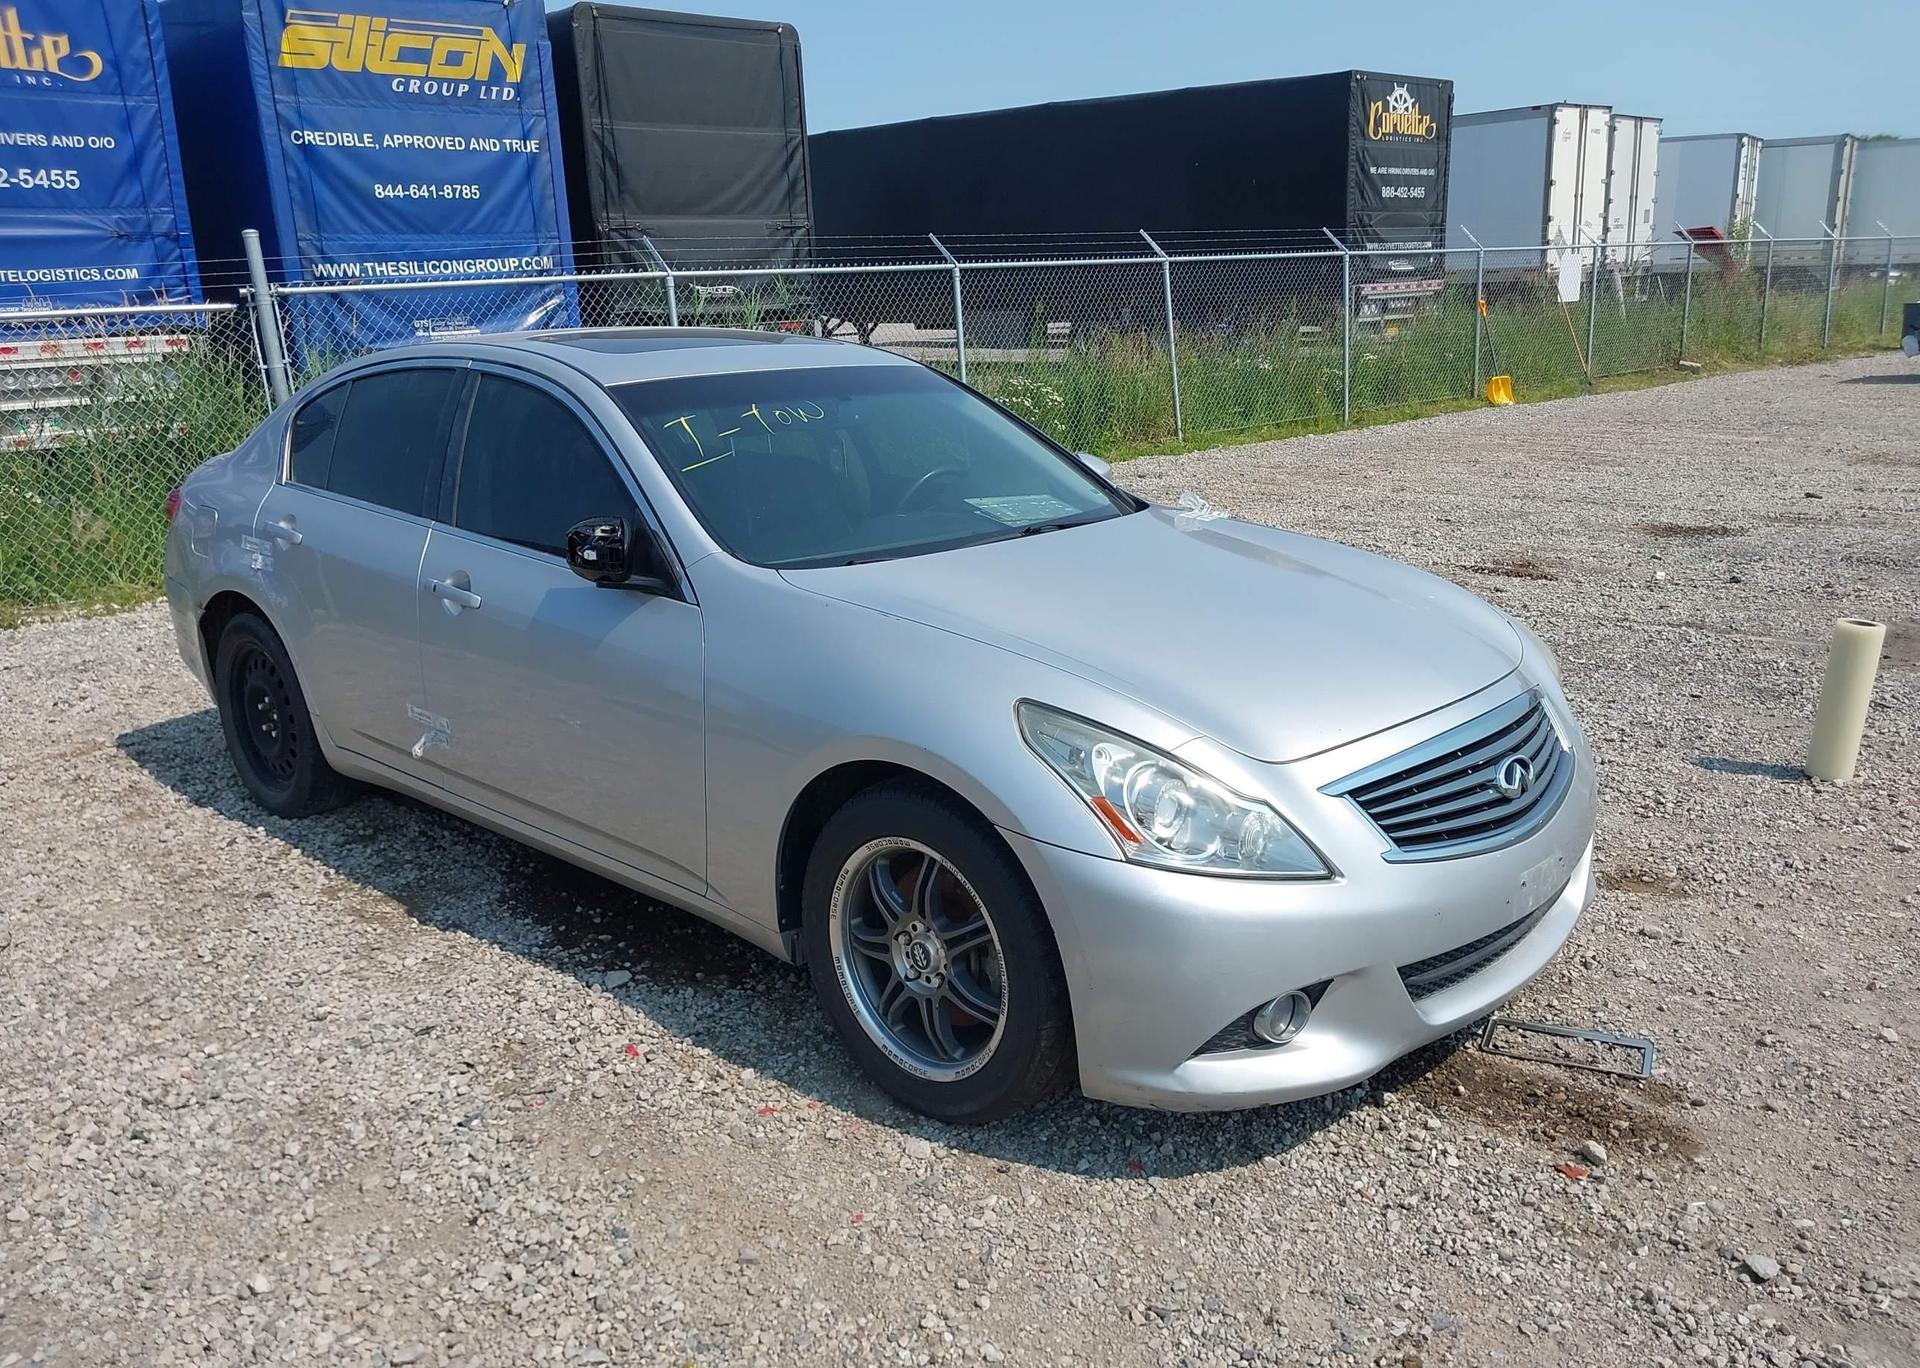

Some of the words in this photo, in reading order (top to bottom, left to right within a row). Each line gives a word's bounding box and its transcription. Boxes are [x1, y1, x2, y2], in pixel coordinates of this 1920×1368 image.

[15, 75, 63, 87] INC.
[391, 78, 470, 97] GROUP
[479, 85, 521, 102] LTD.
[1368, 101, 1437, 140] Corvette
[51, 135, 85, 148] AND
[290, 130, 379, 149] CREDIBLE,
[383, 134, 466, 150] APPROVED
[469, 137, 500, 151] AND
[503, 139, 540, 153] TRUE
[374, 183, 480, 200] 844-641-8785
[1381, 186, 1425, 199] 888-452-5455
[312, 256, 554, 278] WWW.THESILICONGROUP.COM
